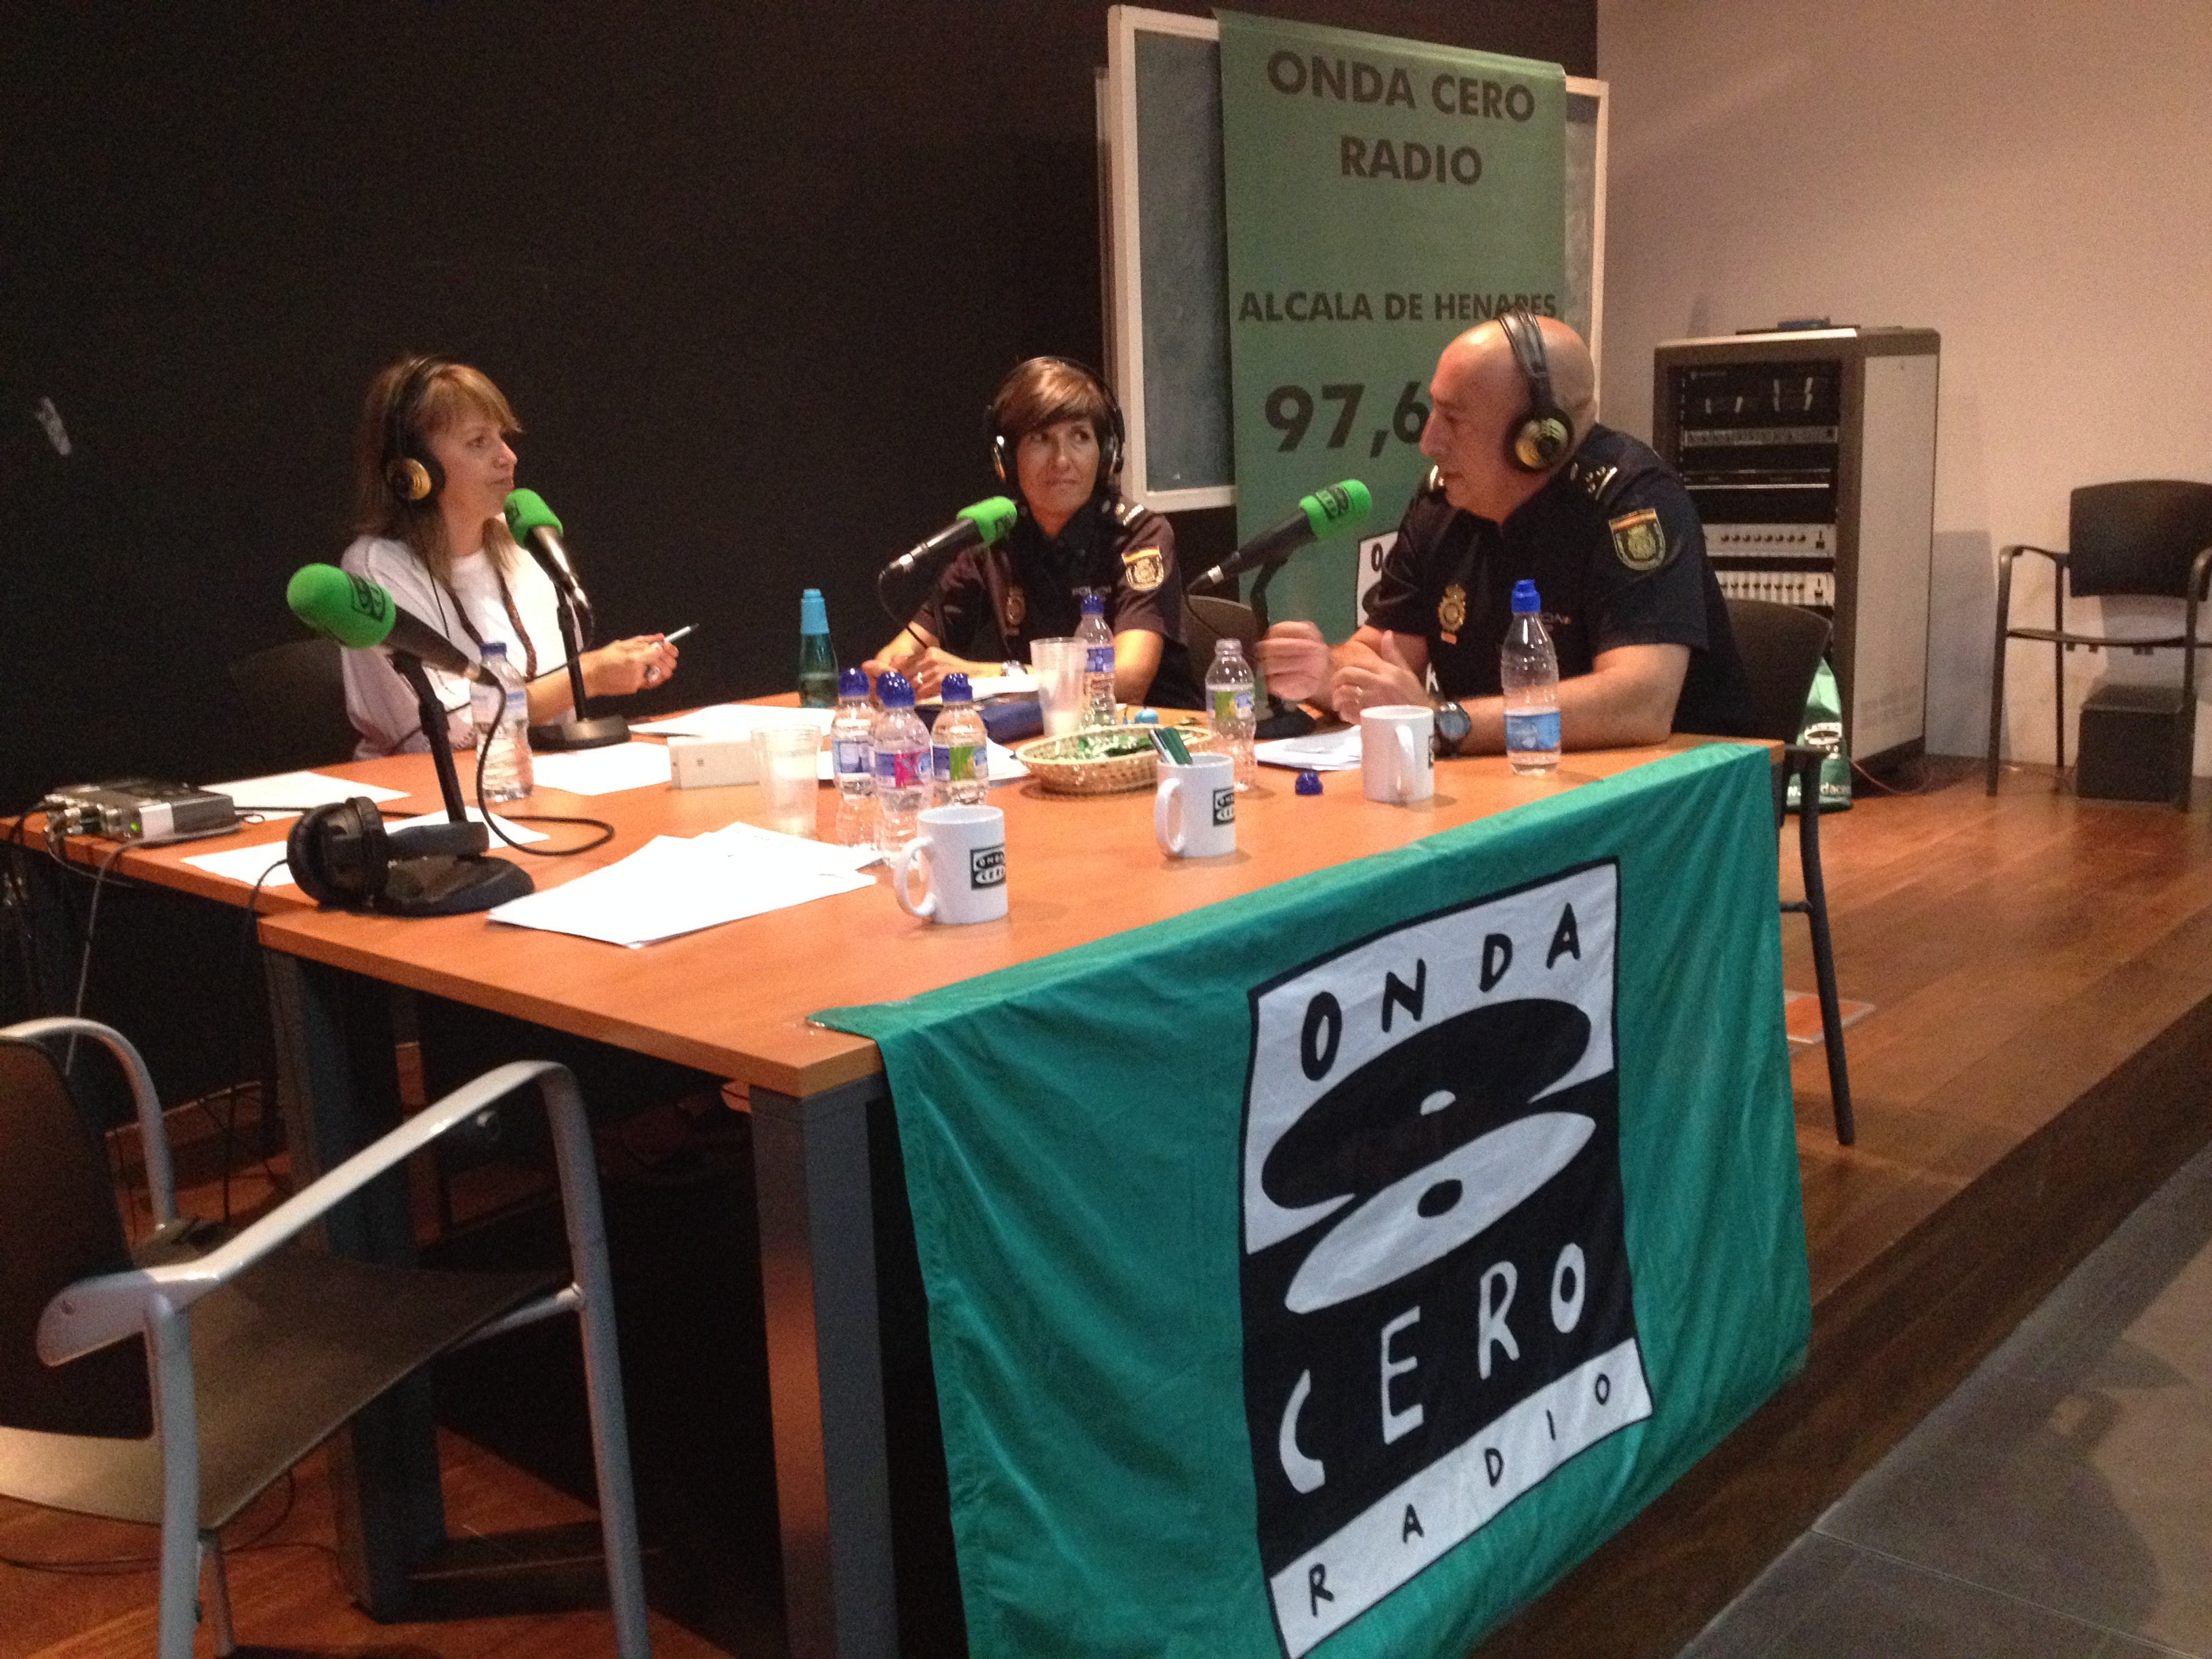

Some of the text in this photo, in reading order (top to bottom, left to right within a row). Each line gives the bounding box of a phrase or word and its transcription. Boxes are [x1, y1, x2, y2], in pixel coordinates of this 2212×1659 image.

[1267, 49, 1535, 122] ONDA CERO
[1340, 136, 1482, 185] RADIO
[1238, 291, 1557, 321] ALCALA DE HENARES
[1265, 381, 1430, 457] 97,6
[1300, 903, 1580, 1081] ONDA
[1279, 1243, 1586, 1494] CERO
[1308, 1374, 1611, 1617] RADIO
